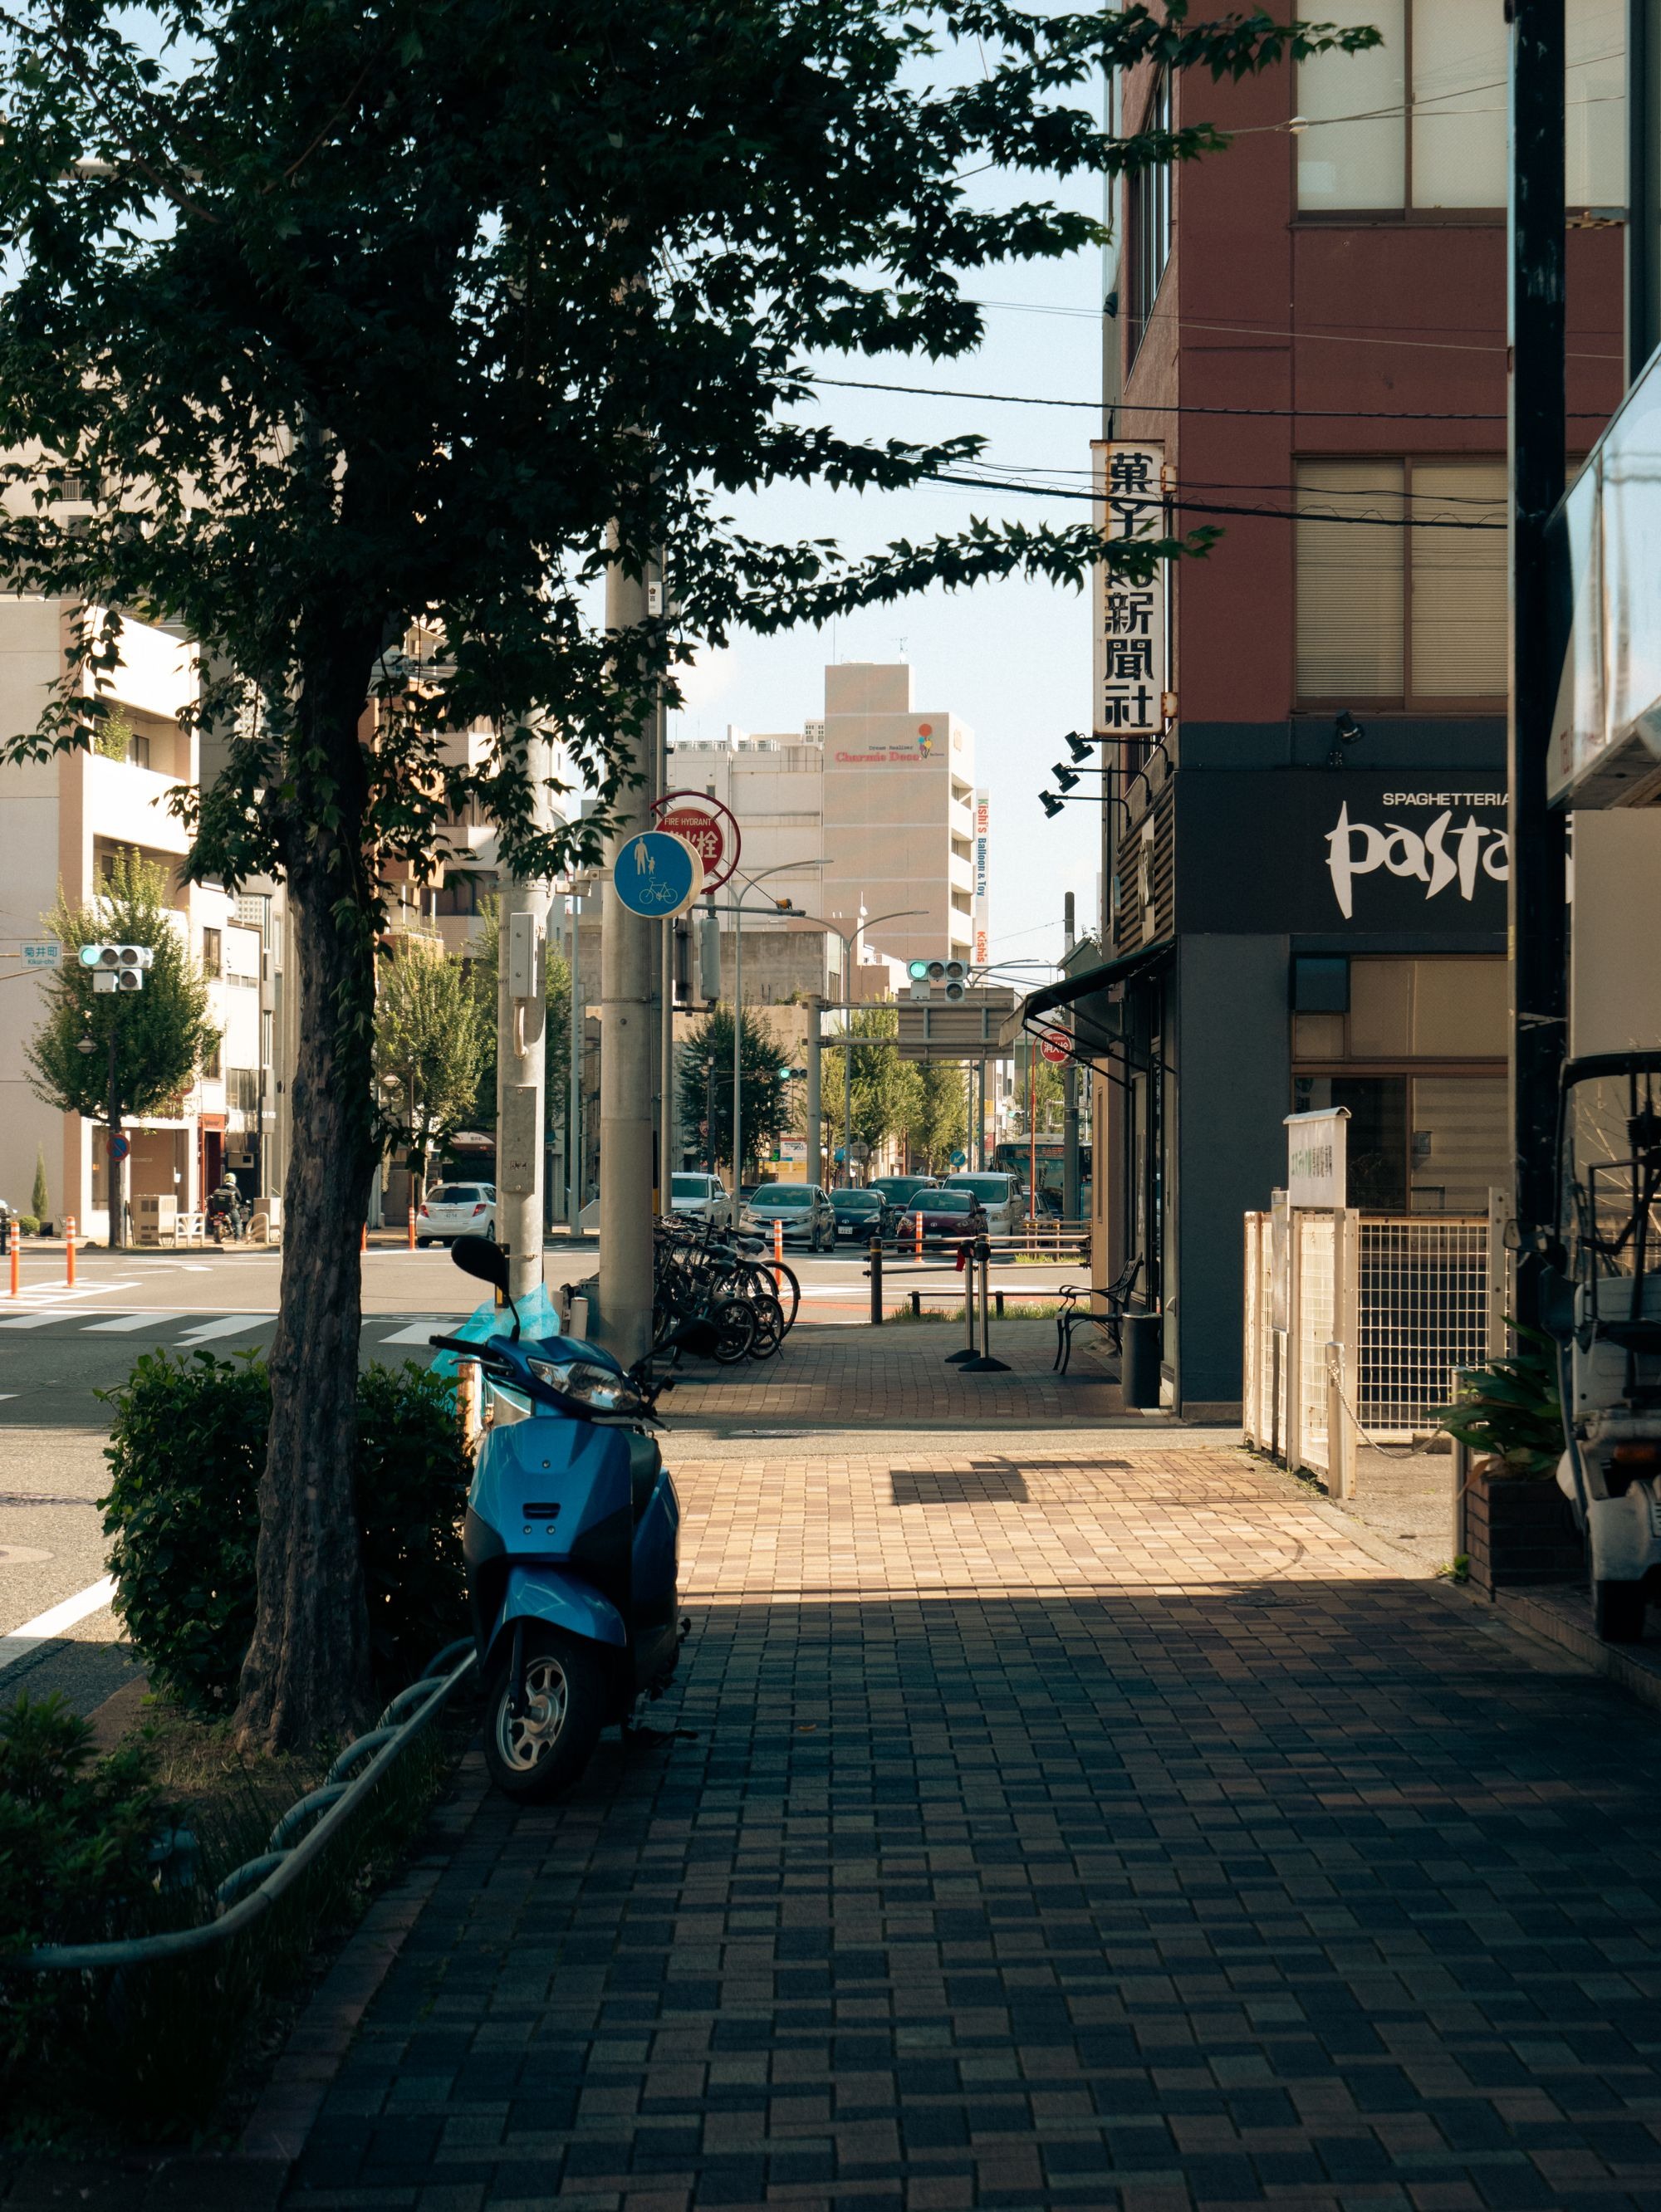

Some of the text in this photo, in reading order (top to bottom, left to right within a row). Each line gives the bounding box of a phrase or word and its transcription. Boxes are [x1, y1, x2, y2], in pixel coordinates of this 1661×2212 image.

[1103, 452, 1154, 728] 菓子新聞社
[1383, 793, 1509, 805] SPAGHETTERIA
[681, 818, 712, 826] HYDRANT
[977, 838, 987, 871] Balloon
[977, 881, 987, 897] Toy
